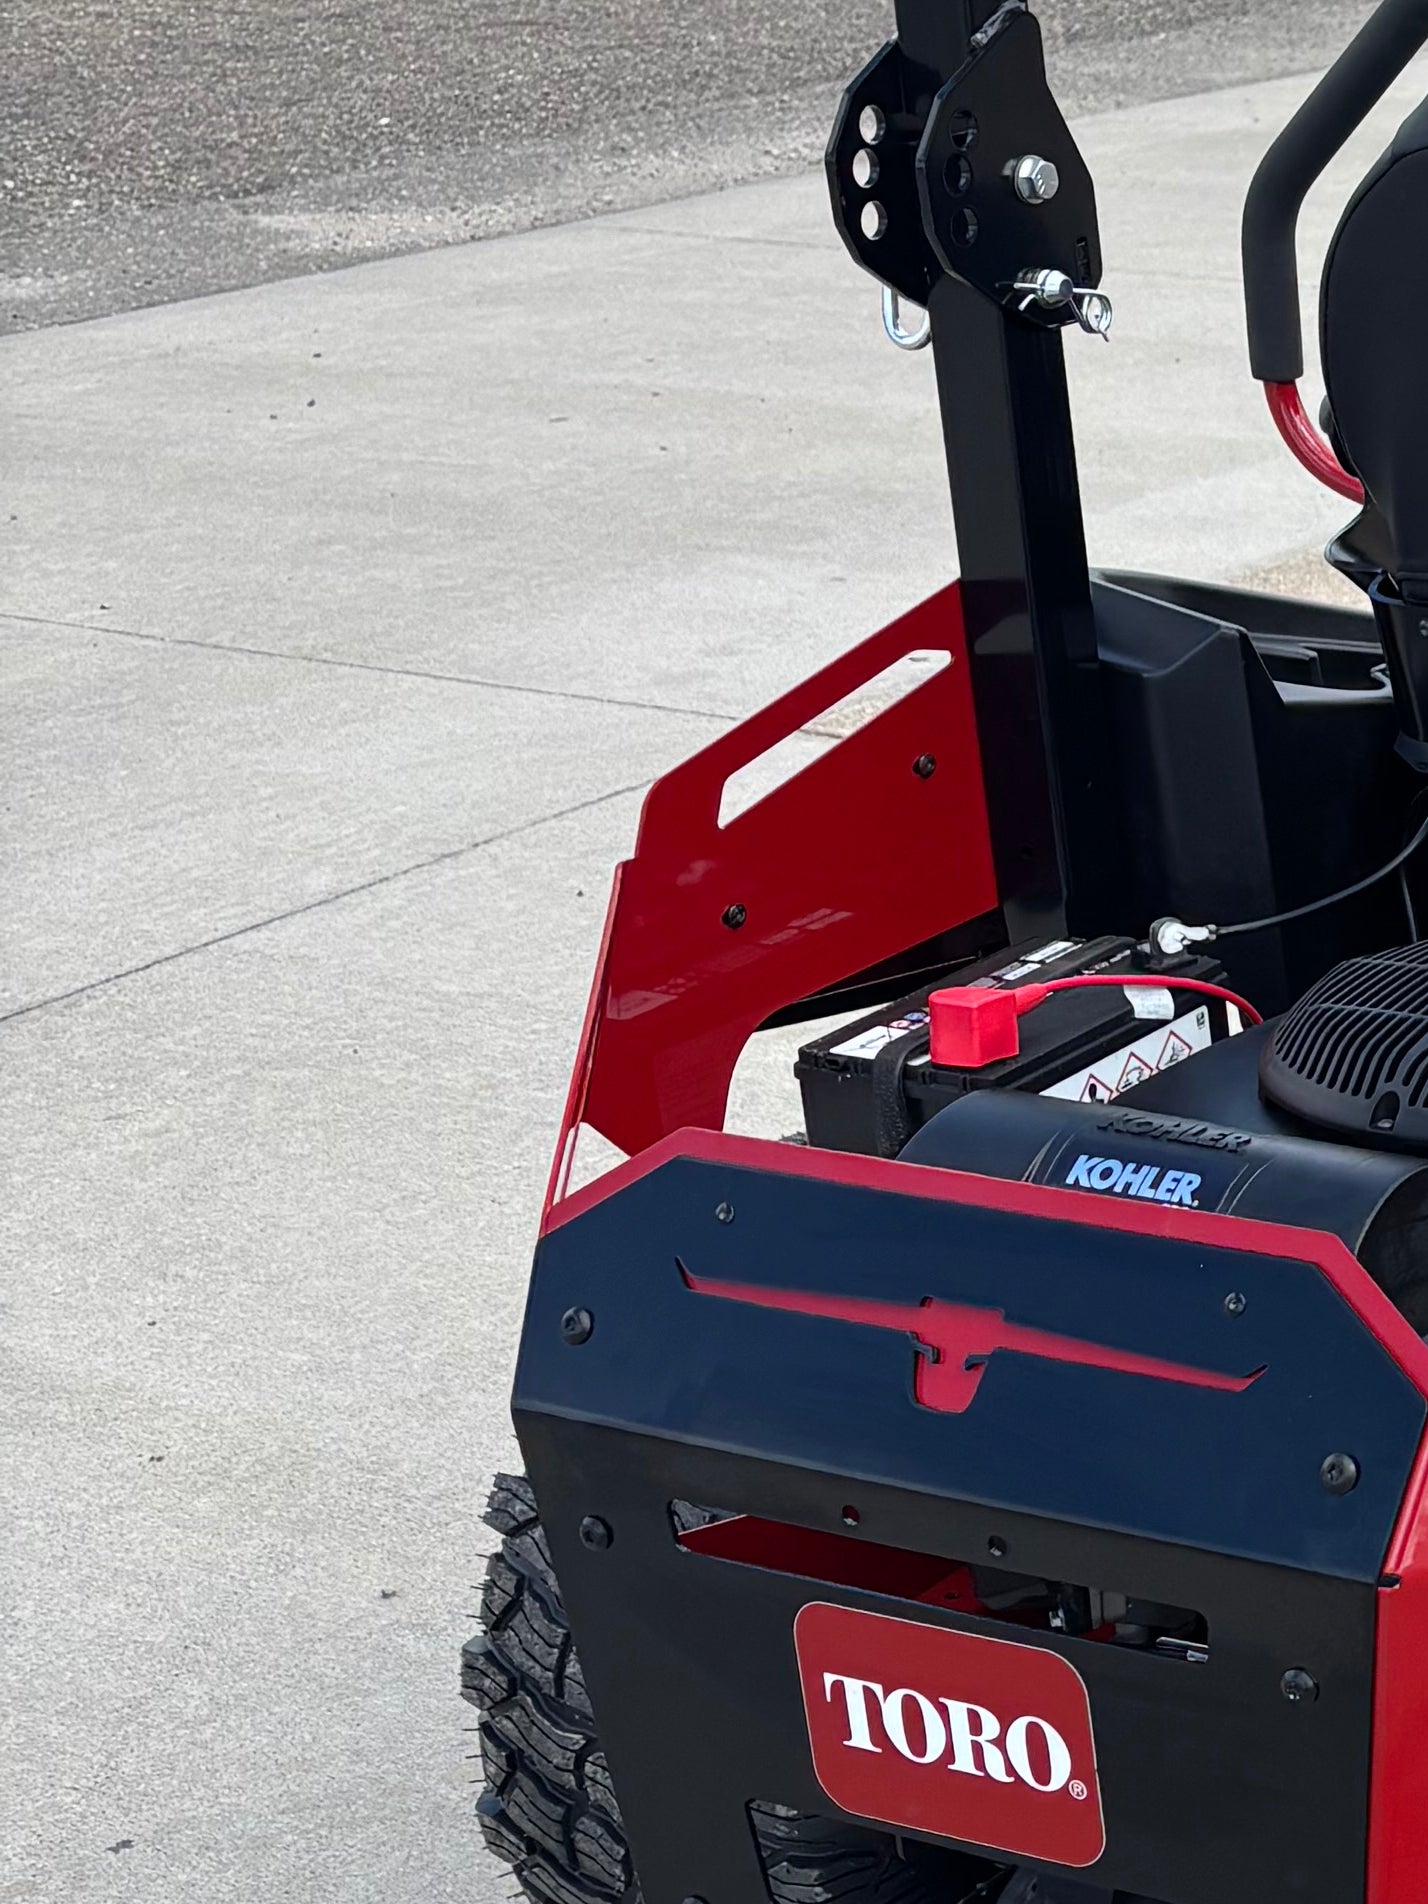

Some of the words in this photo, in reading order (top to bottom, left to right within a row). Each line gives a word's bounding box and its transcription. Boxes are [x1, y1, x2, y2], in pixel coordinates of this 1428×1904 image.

[1096, 1113, 1252, 1153] KOHLER
[1065, 1154, 1202, 1206] KOHLER
[822, 1671, 1072, 1793] TORO
